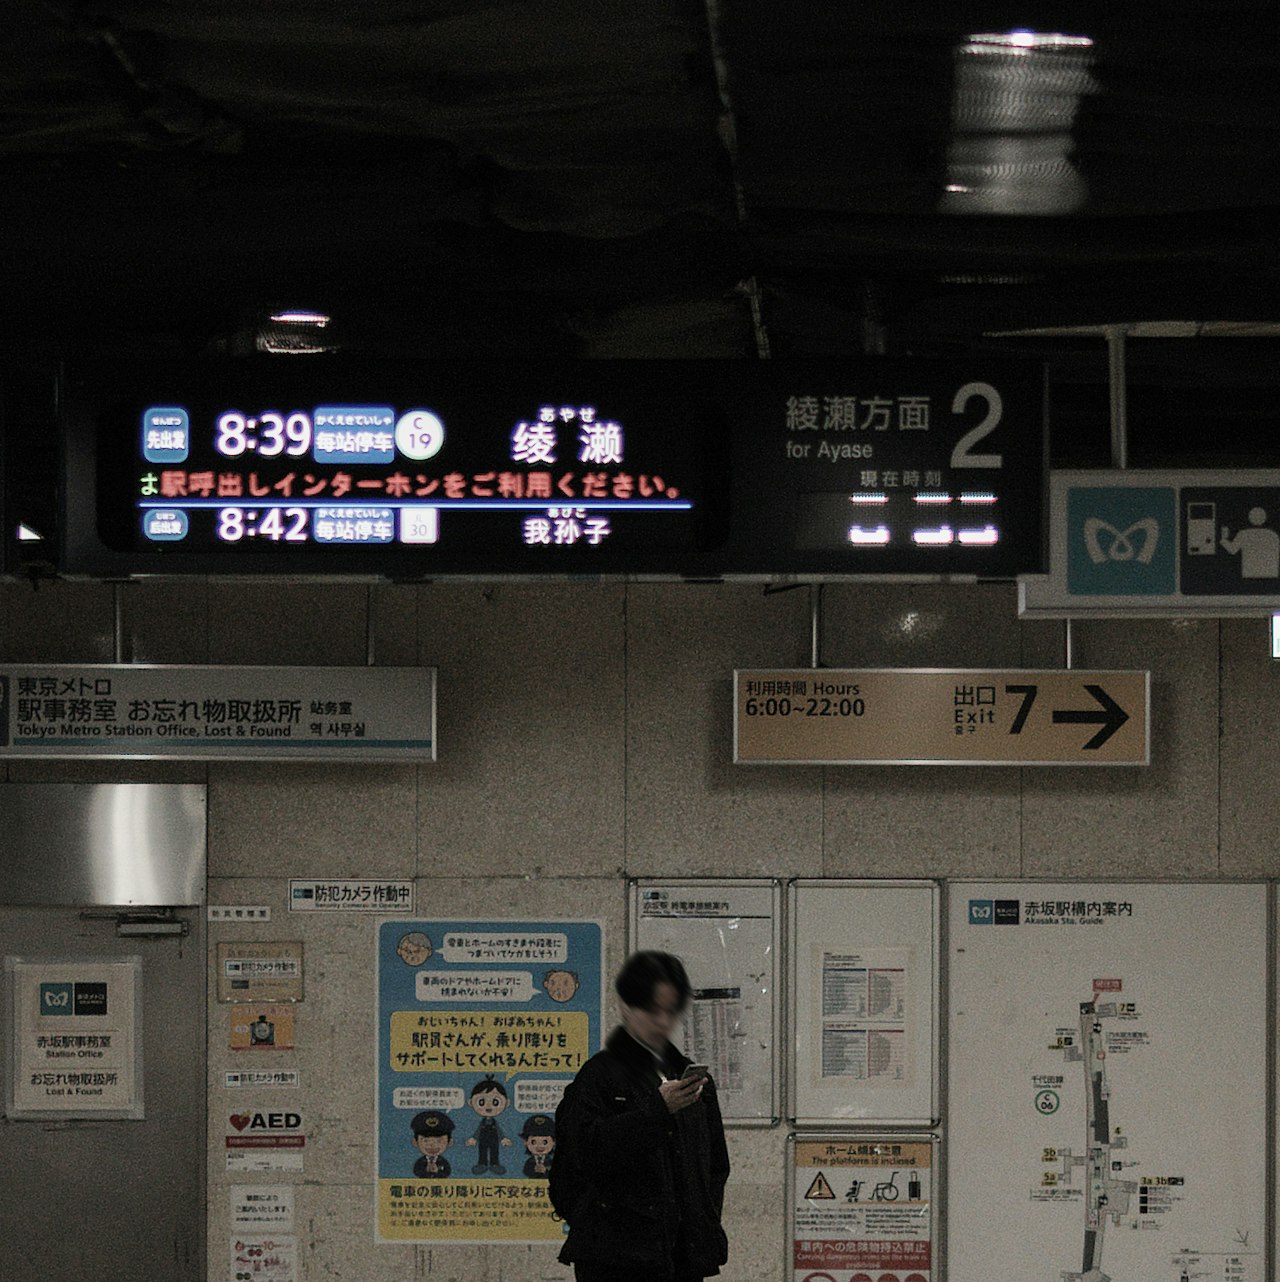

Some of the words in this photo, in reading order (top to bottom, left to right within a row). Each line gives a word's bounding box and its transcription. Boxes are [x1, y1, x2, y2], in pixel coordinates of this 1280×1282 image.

[540, 407, 595, 422] あやせ
[785, 396, 931, 431] 綾瀬方面
[950, 382, 1004, 469] 2
[217, 412, 310, 456] 8:39
[408, 433, 433, 450] 19
[786, 442, 811, 458] for
[817, 442, 873, 463] Ayase
[860, 470, 943, 488] 現在時刻
[218, 507, 308, 541] 8:42
[409, 523, 428, 536] 30
[523, 518, 611, 545] 我孙子
[17, 677, 111, 696] 東京メトロ
[746, 681, 808, 696] 利用時間
[813, 681, 861, 696] Hours
[954, 685, 995, 705] 出口
[17, 699, 117, 723] 駅事務室
[128, 699, 302, 723] お忘れ物取扱所
[955, 708, 995, 724] Exit
[1005, 685, 1037, 734] 7
[17, 724, 56, 738] Tokyo
[60, 724, 101, 736] Metro
[105, 724, 153, 736] Station
[157, 724, 200, 738] Office,
[205, 725, 231, 737] Lost
[236, 726, 246, 737] &
[251, 725, 291, 737] Found
[328, 723, 366, 737] 사무실
[315, 885, 411, 902] 防犯カメラ作動中
[1024, 902, 1133, 917] 赤坂駅構内案内
[1024, 918, 1059, 926] Akasaka
[1079, 918, 1104, 926] Guide
[37, 1035, 111, 1048] 赤坂駅事務室
[412, 1031, 567, 1048] 駅員さんが、乗り降りを
[46, 1050, 76, 1058] Station
[77, 1050, 104, 1058] Office
[396, 1051, 582, 1067] サポートしてくれるんだって！
[30, 1072, 118, 1085] お忘れ物取扱所
[46, 1088, 65, 1096] Lost
[75, 1088, 103, 1096] Found
[250, 1113, 301, 1129] AED
[812, 1157, 827, 1165] The
[830, 1156, 869, 1167] platform
[871, 1157, 879, 1165] is
[881, 1156, 916, 1165] inclined
[800, 1241, 927, 1253] 車内への危険物持込禁止
